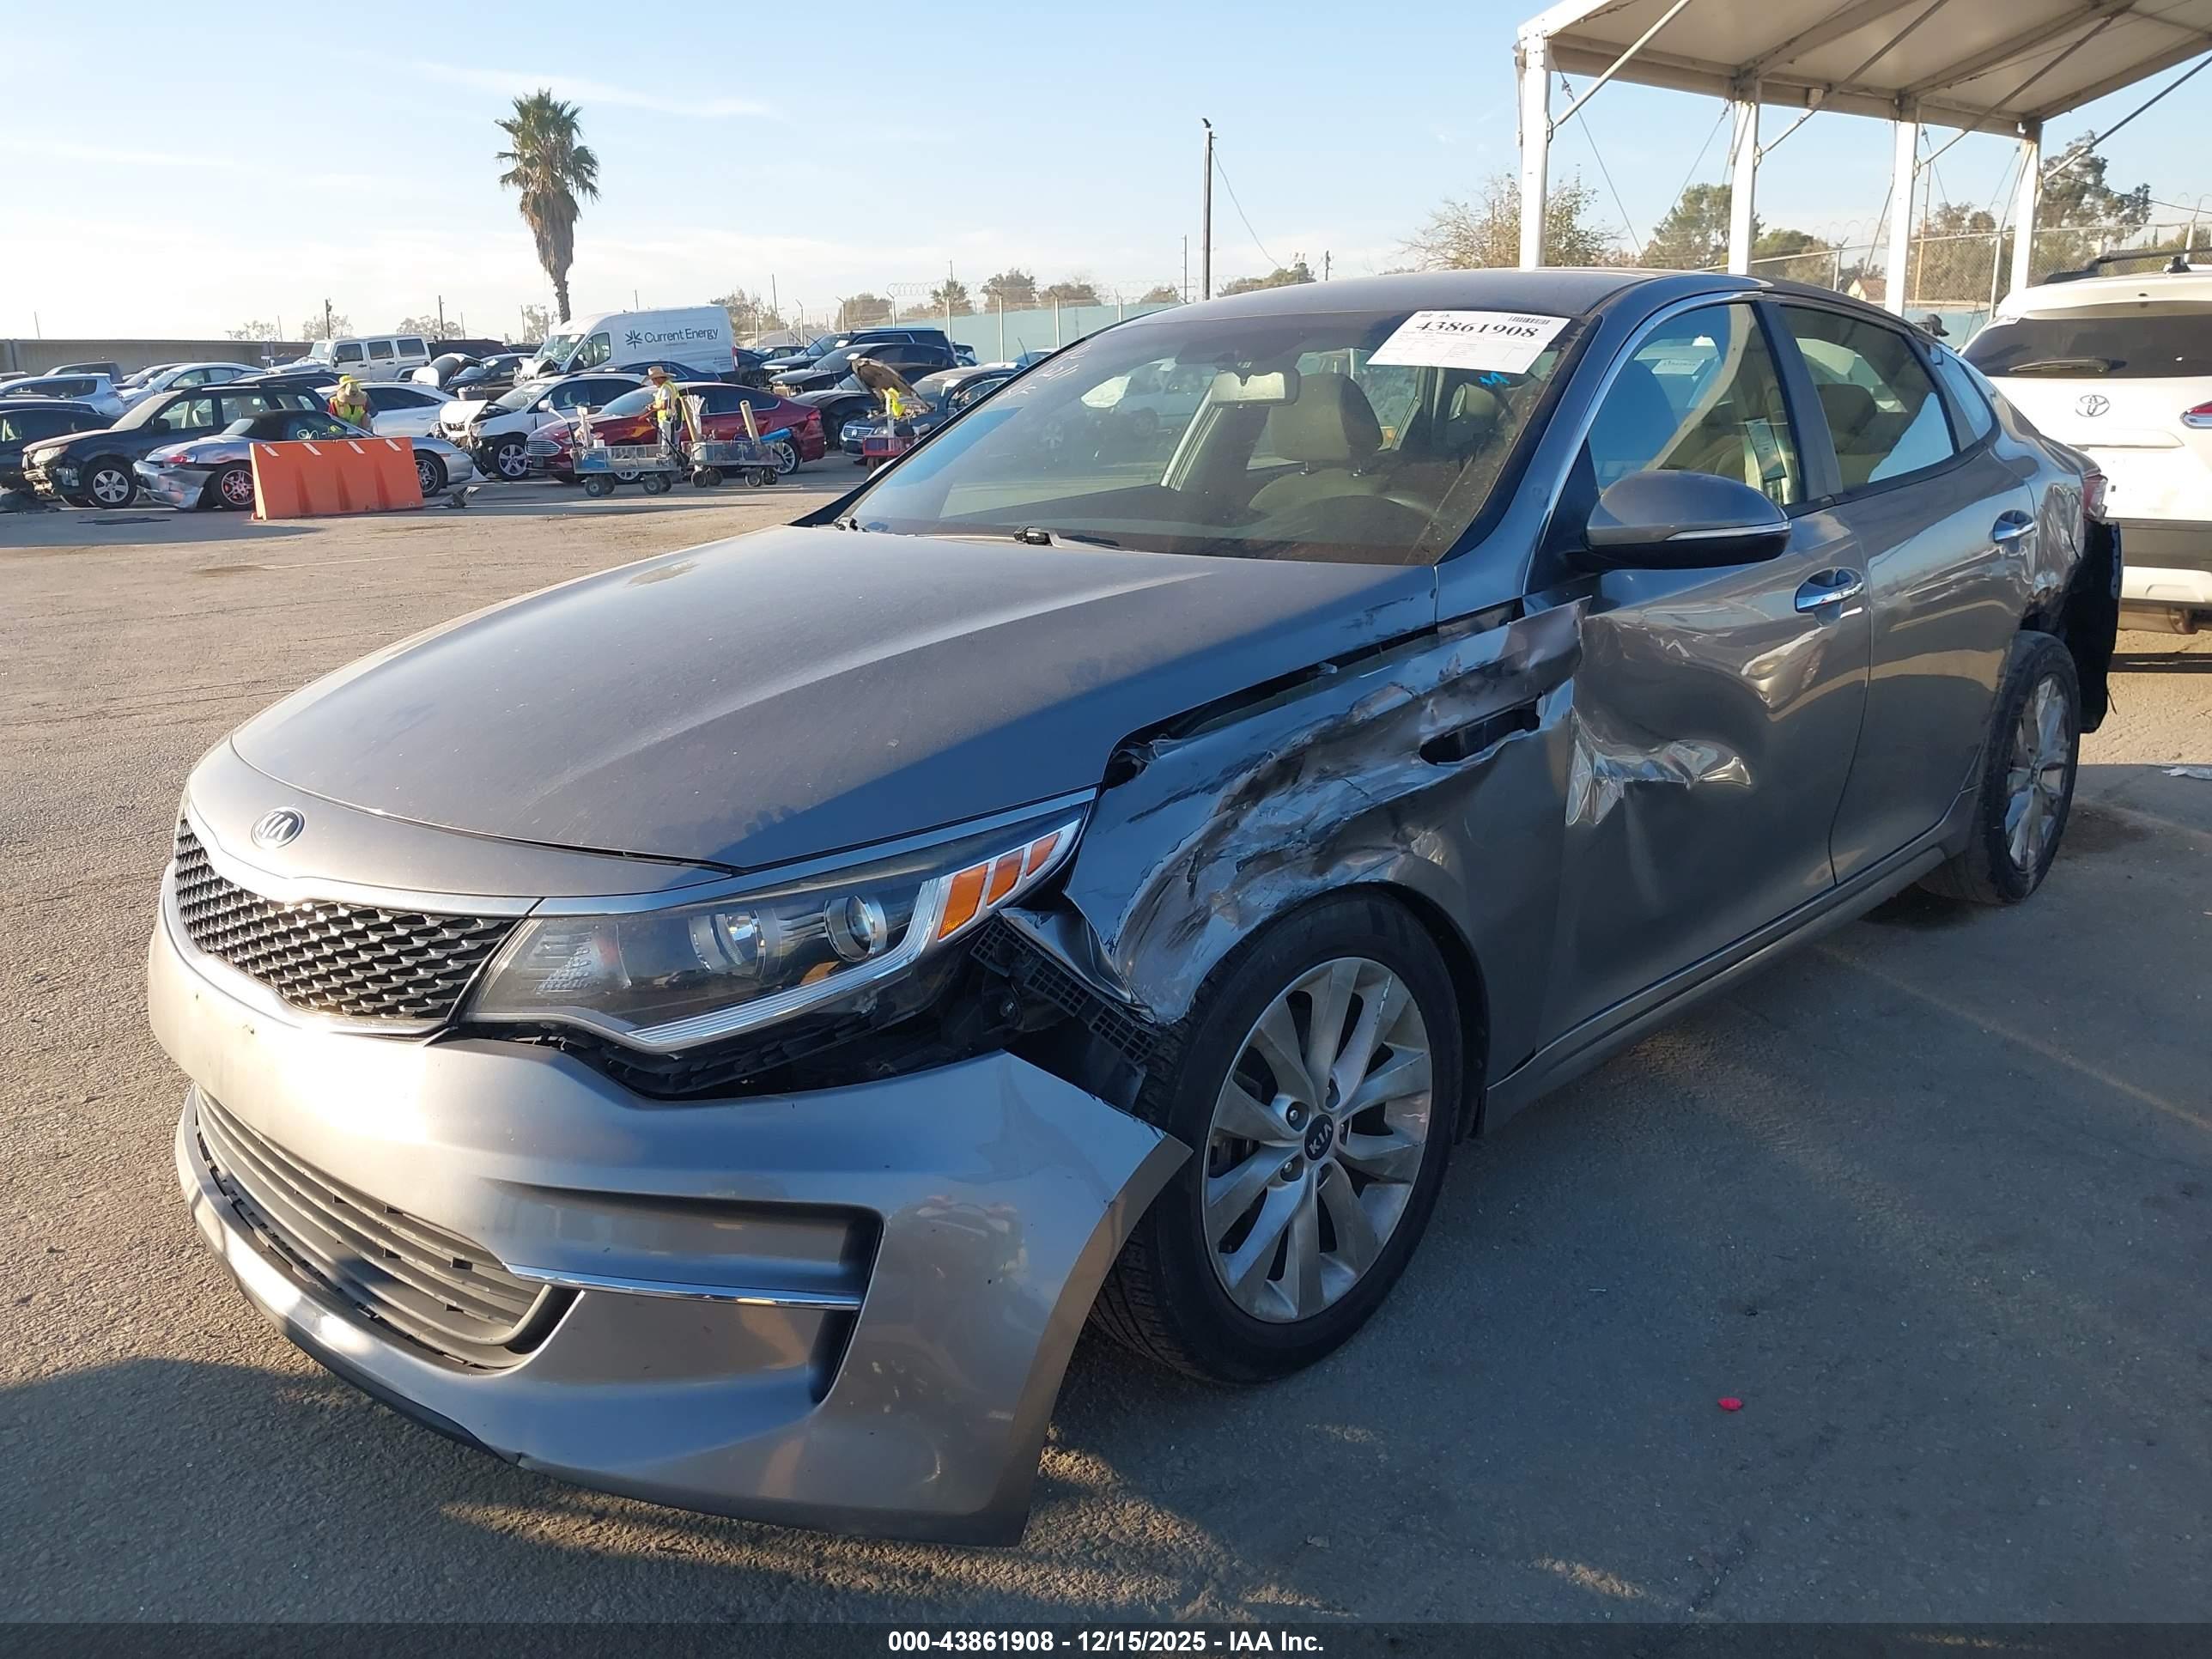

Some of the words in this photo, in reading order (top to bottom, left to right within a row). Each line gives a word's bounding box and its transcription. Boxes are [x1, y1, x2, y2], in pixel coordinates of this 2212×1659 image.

[644, 330, 684, 343] Current
[685, 328, 719, 340] Energy
[1415, 321, 1540, 338] 43861908
[1309, 1123, 1332, 1155] KIA
